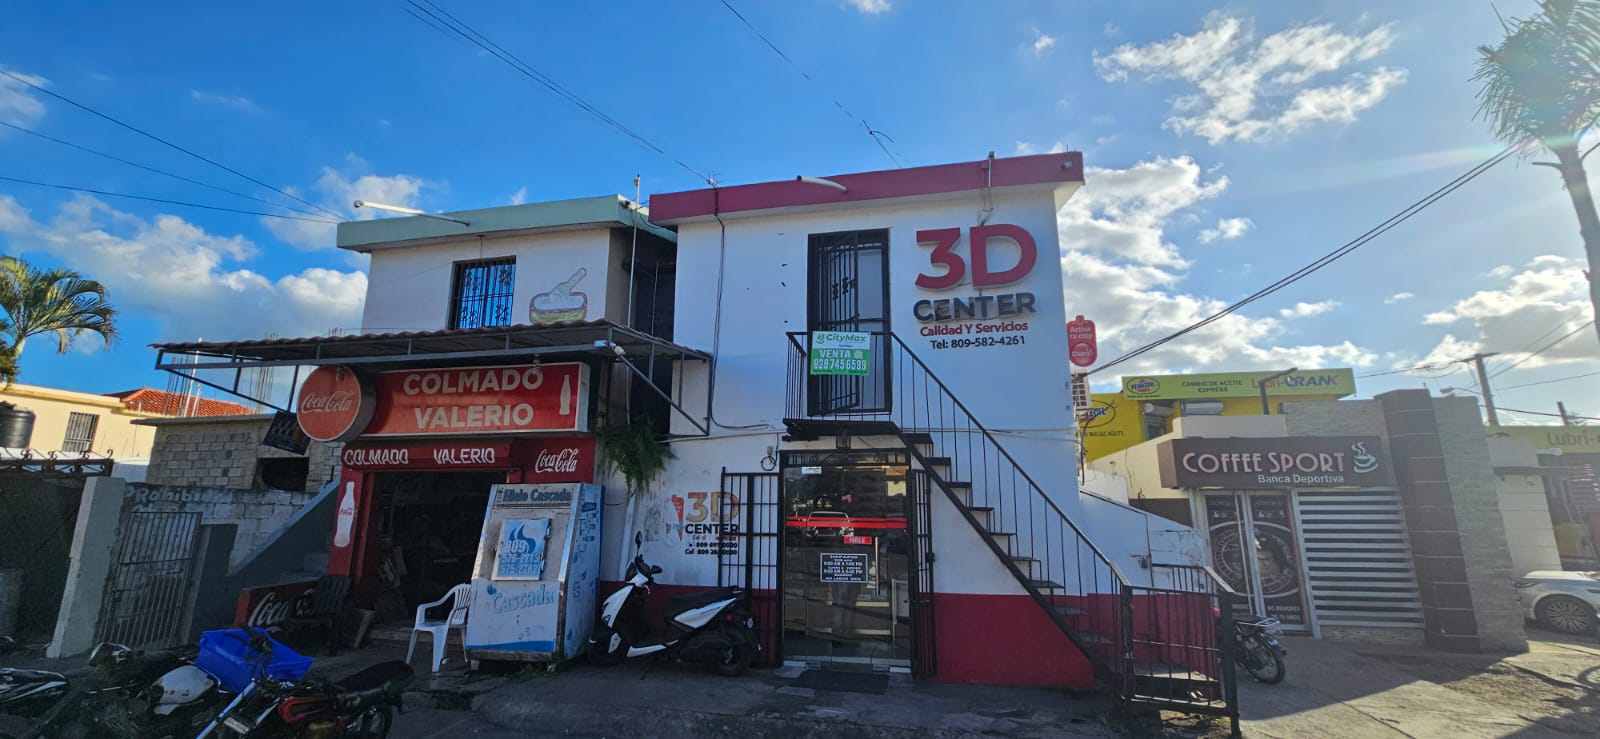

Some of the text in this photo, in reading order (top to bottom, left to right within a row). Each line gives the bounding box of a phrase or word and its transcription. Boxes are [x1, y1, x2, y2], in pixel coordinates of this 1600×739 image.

[914, 224, 1037, 289] 3D
[913, 292, 1036, 321] CENTER
[826, 333, 866, 342] CityMax
[920, 321, 1028, 337] Calidad Y Servicios
[930, 336, 1025, 350] Tel: 809-582-4261
[820, 350, 850, 358] VENTA
[830, 359, 844, 369] 745
[404, 367, 544, 395] COLMADO
[302, 391, 355, 413] Coca-Cola
[414, 403, 534, 429] VALERIO
[344, 447, 496, 465] COLMADO VALERIO
[535, 448, 579, 473] Coca-Cola
[1183, 452, 1344, 473] COFFEE SPORT
[1258, 474, 1344, 484] Banca Deportiva
[531, 488, 572, 501] Cascada
[686, 492, 739, 522] 3D
[685, 523, 739, 535] CENTER
[494, 583, 554, 613] Cascada
